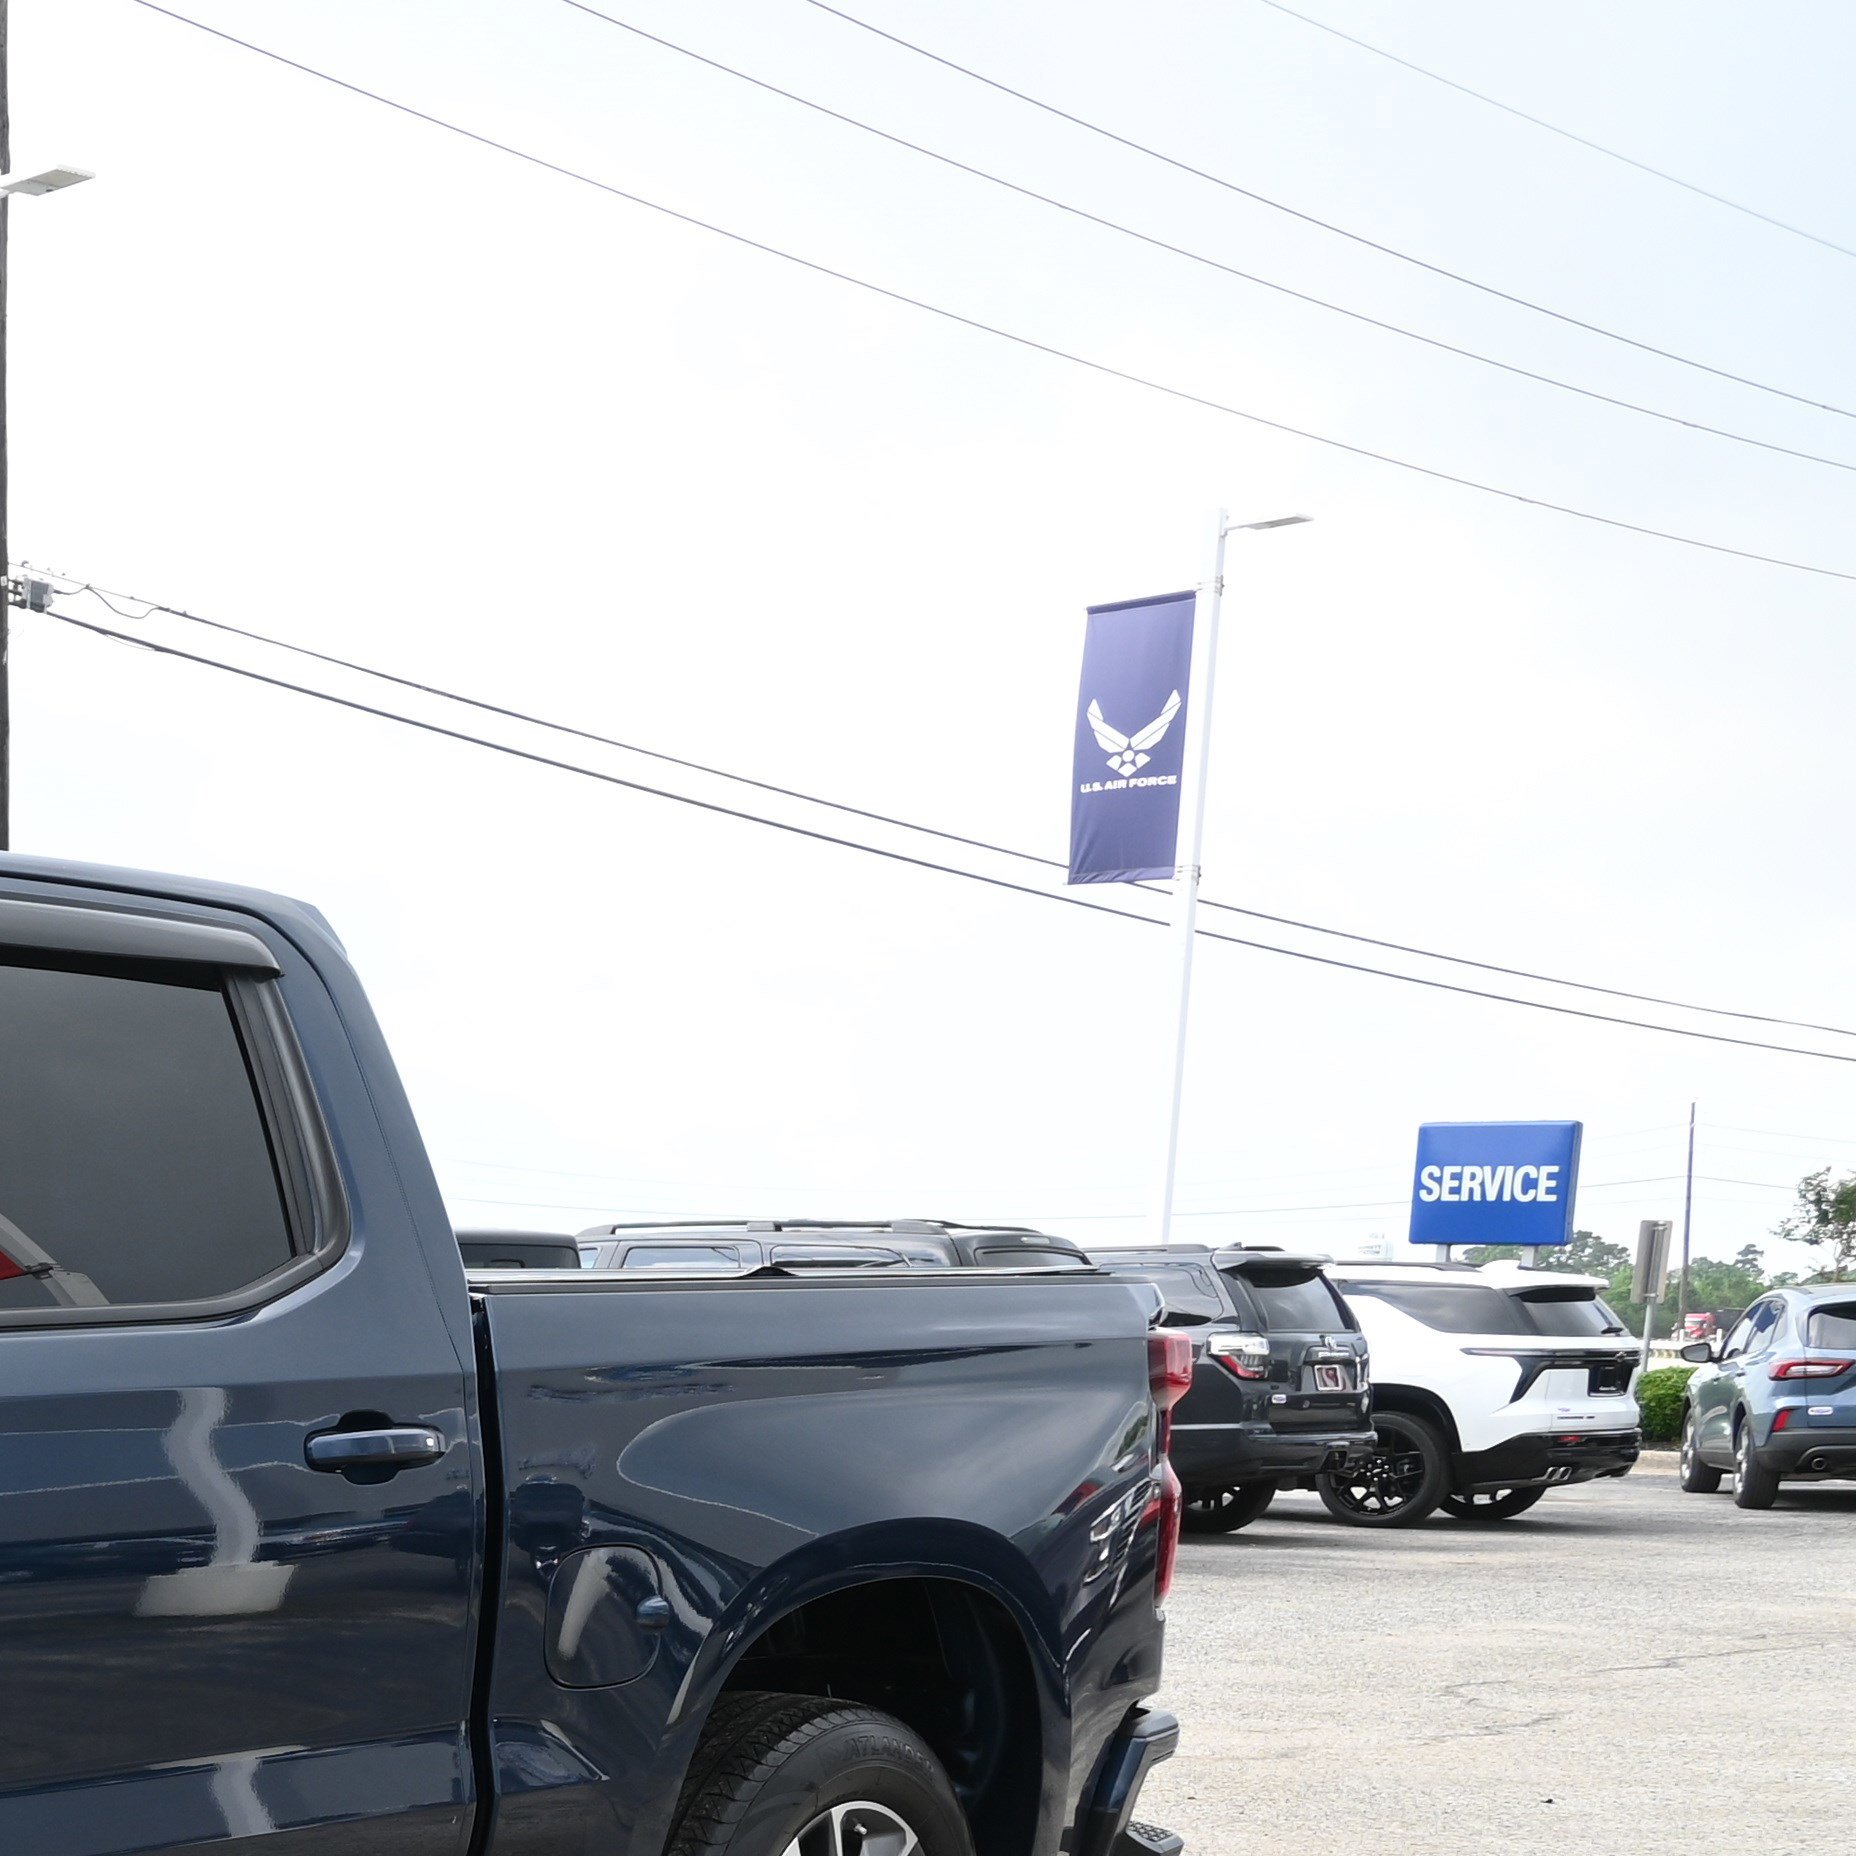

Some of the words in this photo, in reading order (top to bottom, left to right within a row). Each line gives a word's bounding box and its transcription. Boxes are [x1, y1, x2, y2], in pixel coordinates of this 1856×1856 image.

[1080, 781, 1103, 793] U.S.
[1104, 779, 1127, 790] AIR
[1129, 775, 1177, 788] FORCE
[1418, 1164, 1560, 1202] SERVICE
